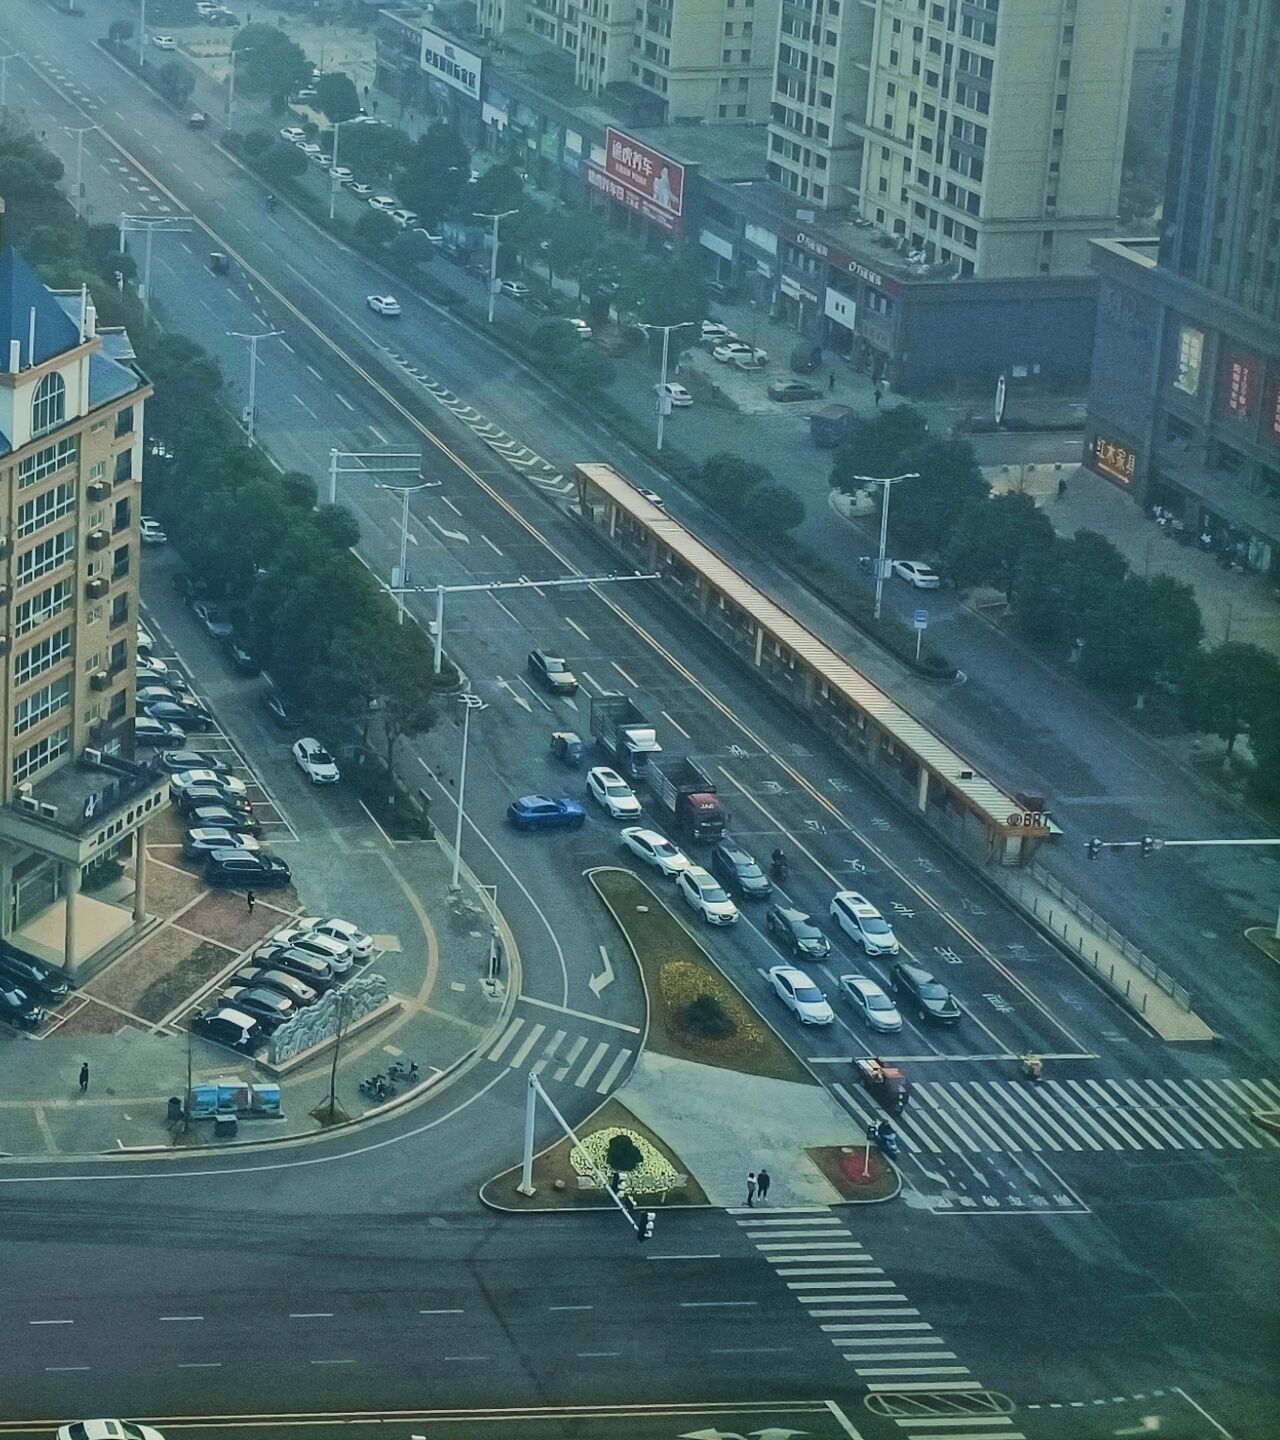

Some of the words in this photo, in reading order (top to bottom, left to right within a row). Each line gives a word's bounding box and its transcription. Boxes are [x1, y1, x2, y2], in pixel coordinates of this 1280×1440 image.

[612, 140, 654, 176] 途虎养车
[1024, 812, 1051, 827] BRT
